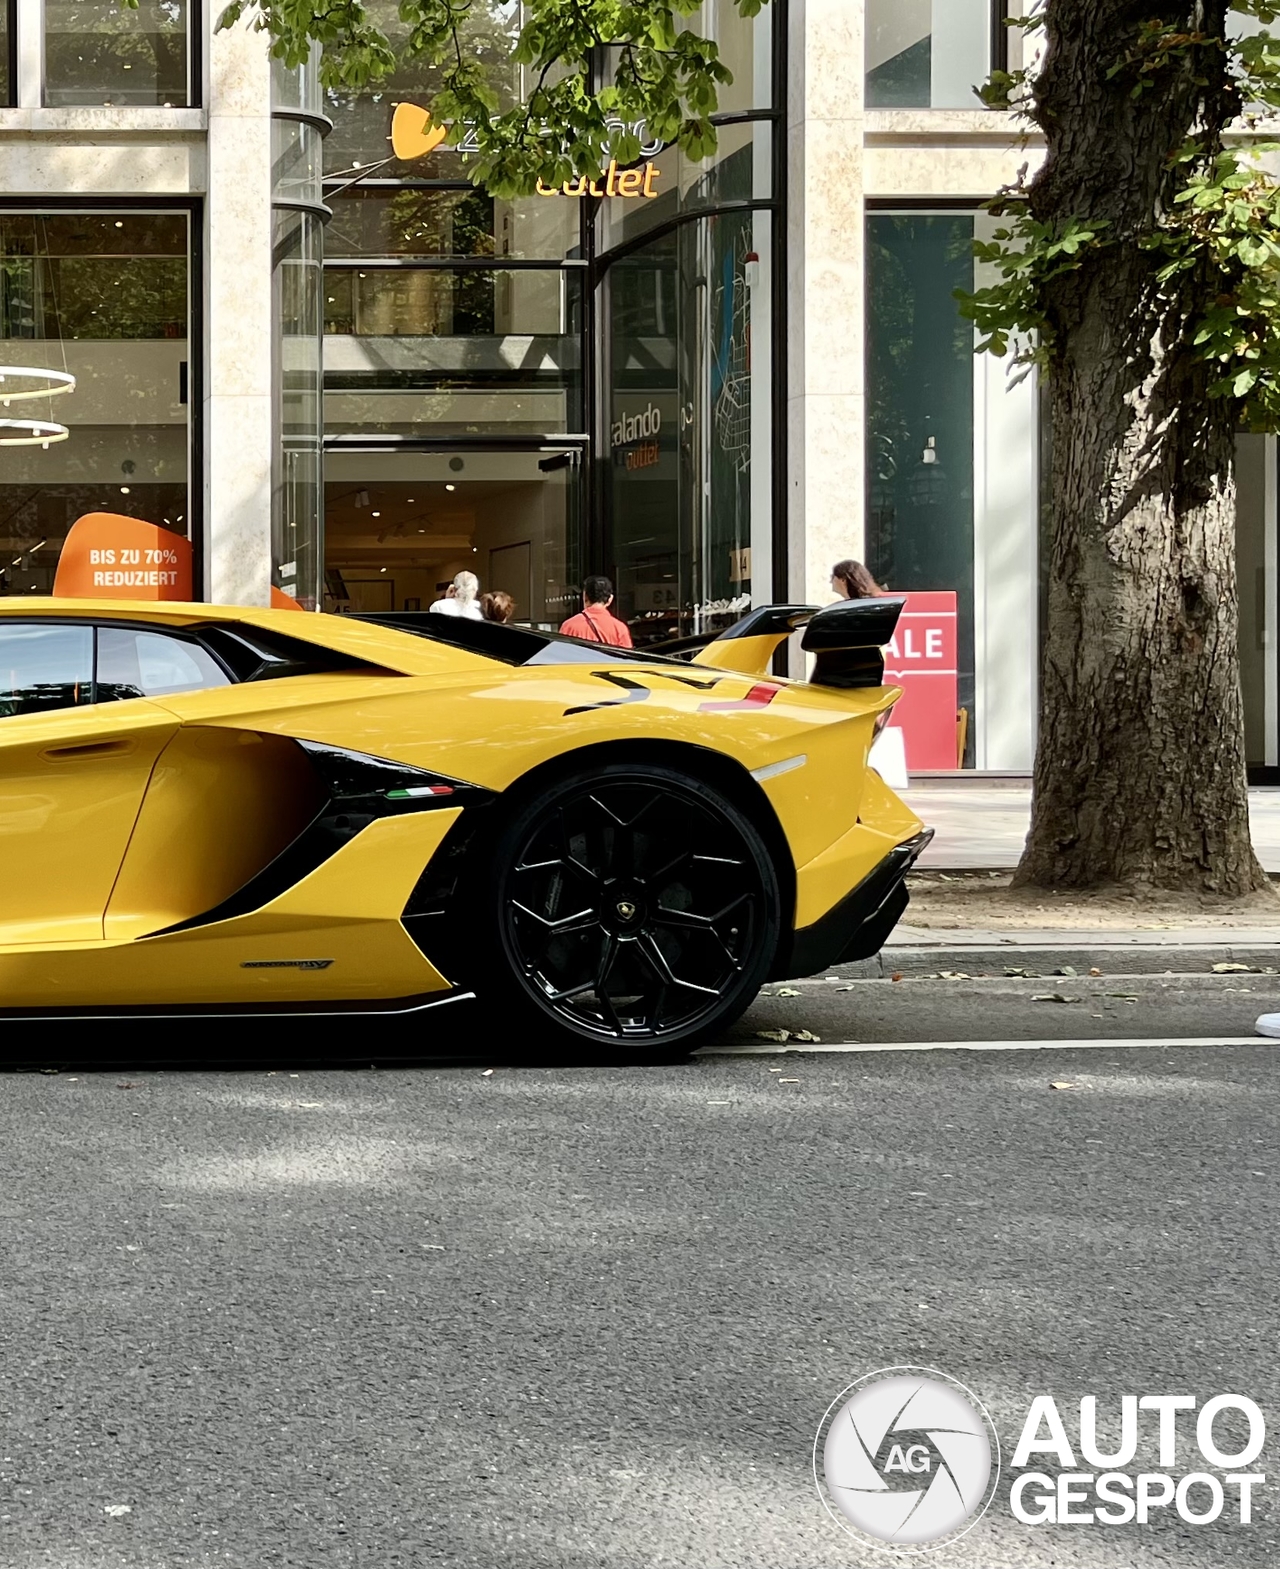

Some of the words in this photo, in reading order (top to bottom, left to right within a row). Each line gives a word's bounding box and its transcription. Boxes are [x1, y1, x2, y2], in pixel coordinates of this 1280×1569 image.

[89, 549, 116, 565] BIS
[120, 549, 140, 565] ZU
[144, 549, 178, 565] 70%
[93, 570, 178, 587] REDUZIERT
[885, 629, 943, 658] ALE
